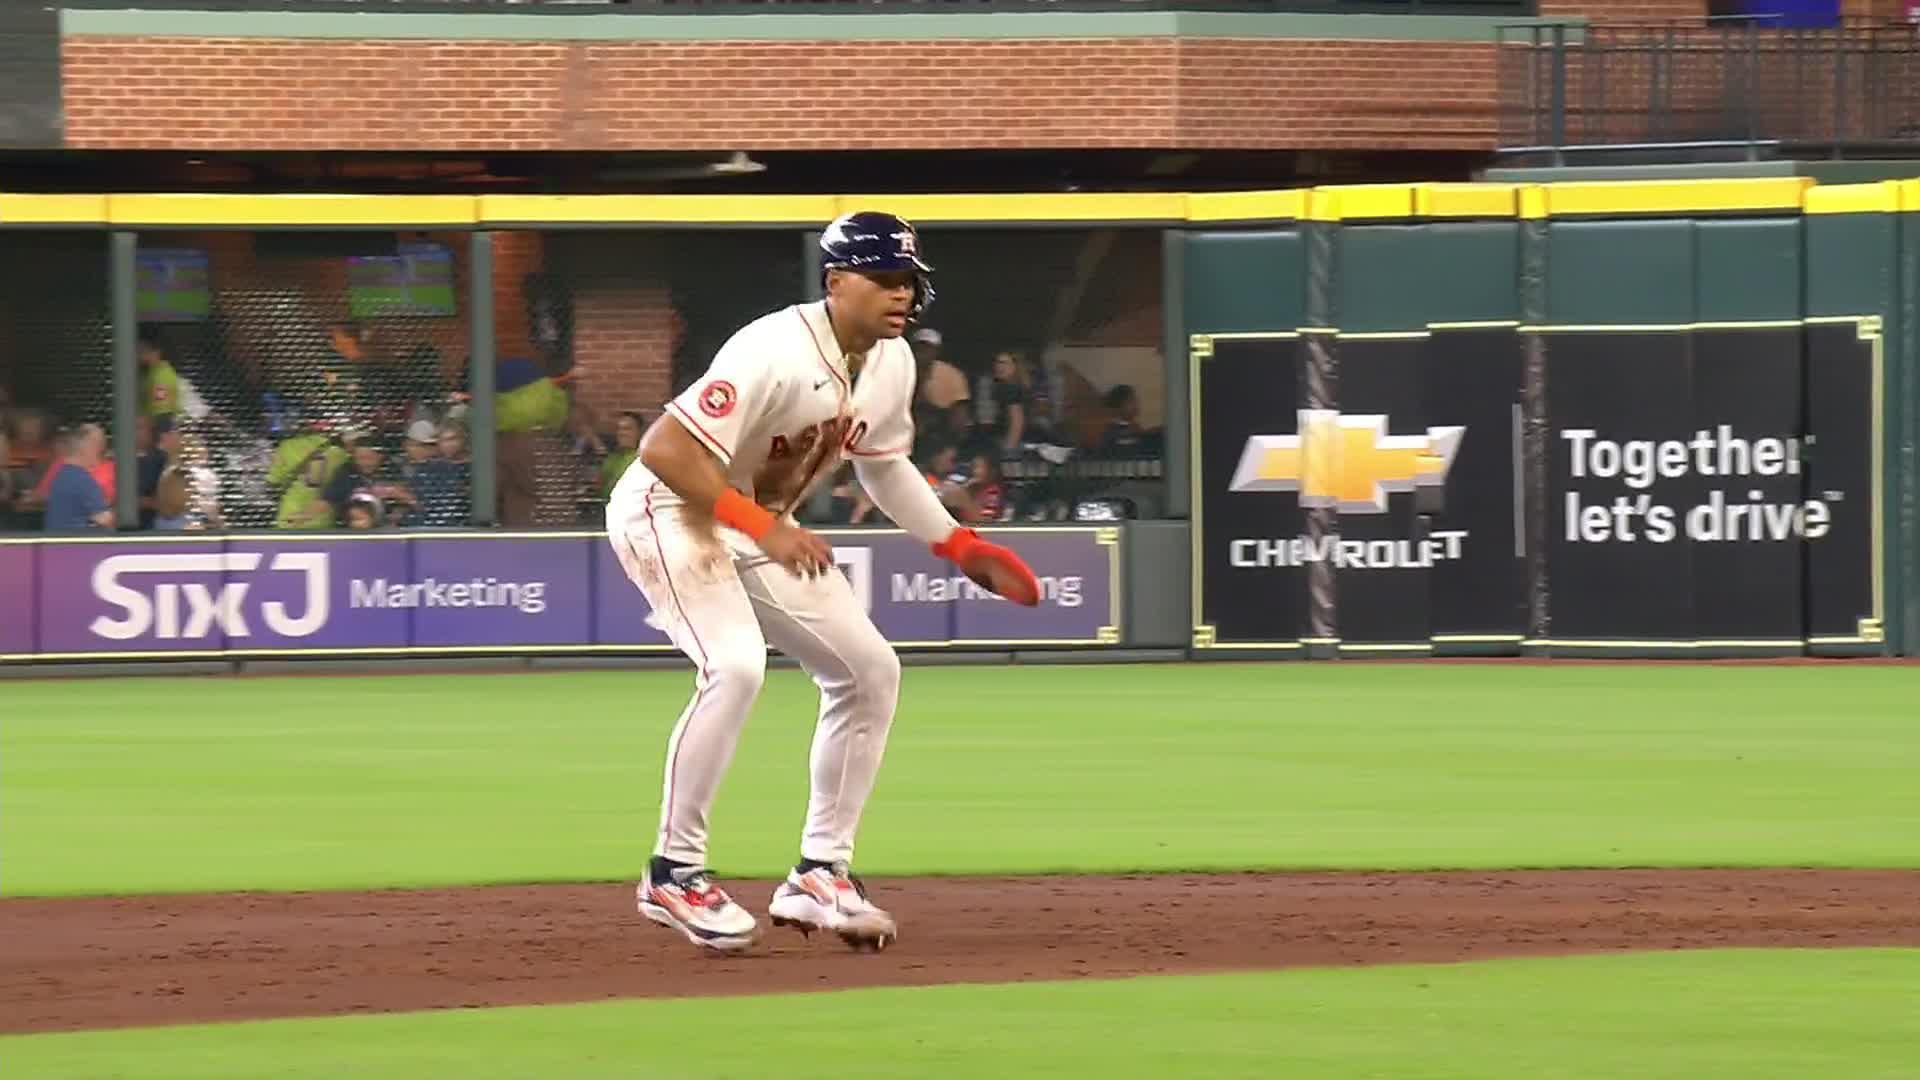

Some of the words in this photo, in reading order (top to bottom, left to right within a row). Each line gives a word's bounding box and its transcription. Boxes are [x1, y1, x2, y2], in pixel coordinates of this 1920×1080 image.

[1565, 491, 1677, 543] let's
[1229, 530, 1469, 569] CHEVROLET
[261, 552, 330, 637] J
[350, 578, 547, 613] Marketing
